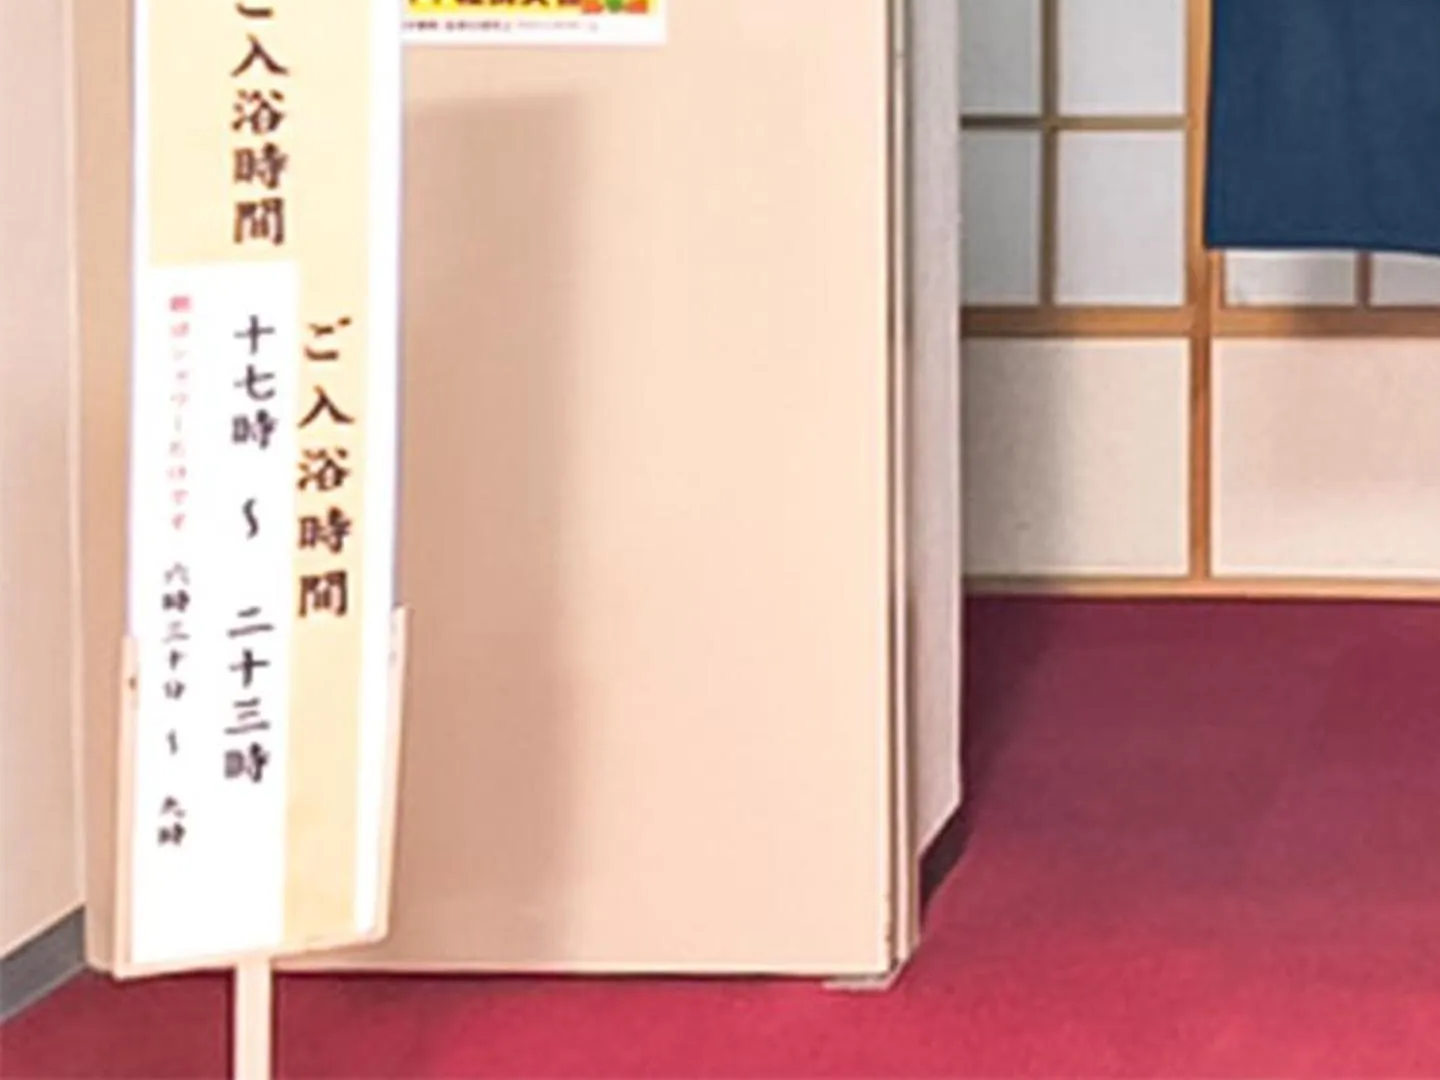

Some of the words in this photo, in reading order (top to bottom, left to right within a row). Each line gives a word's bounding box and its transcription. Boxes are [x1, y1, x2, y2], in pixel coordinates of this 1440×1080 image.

[231, 314, 277, 450] 十七時
[297, 316, 355, 619] ご入浴時間
[224, 606, 275, 784] 二十三時
